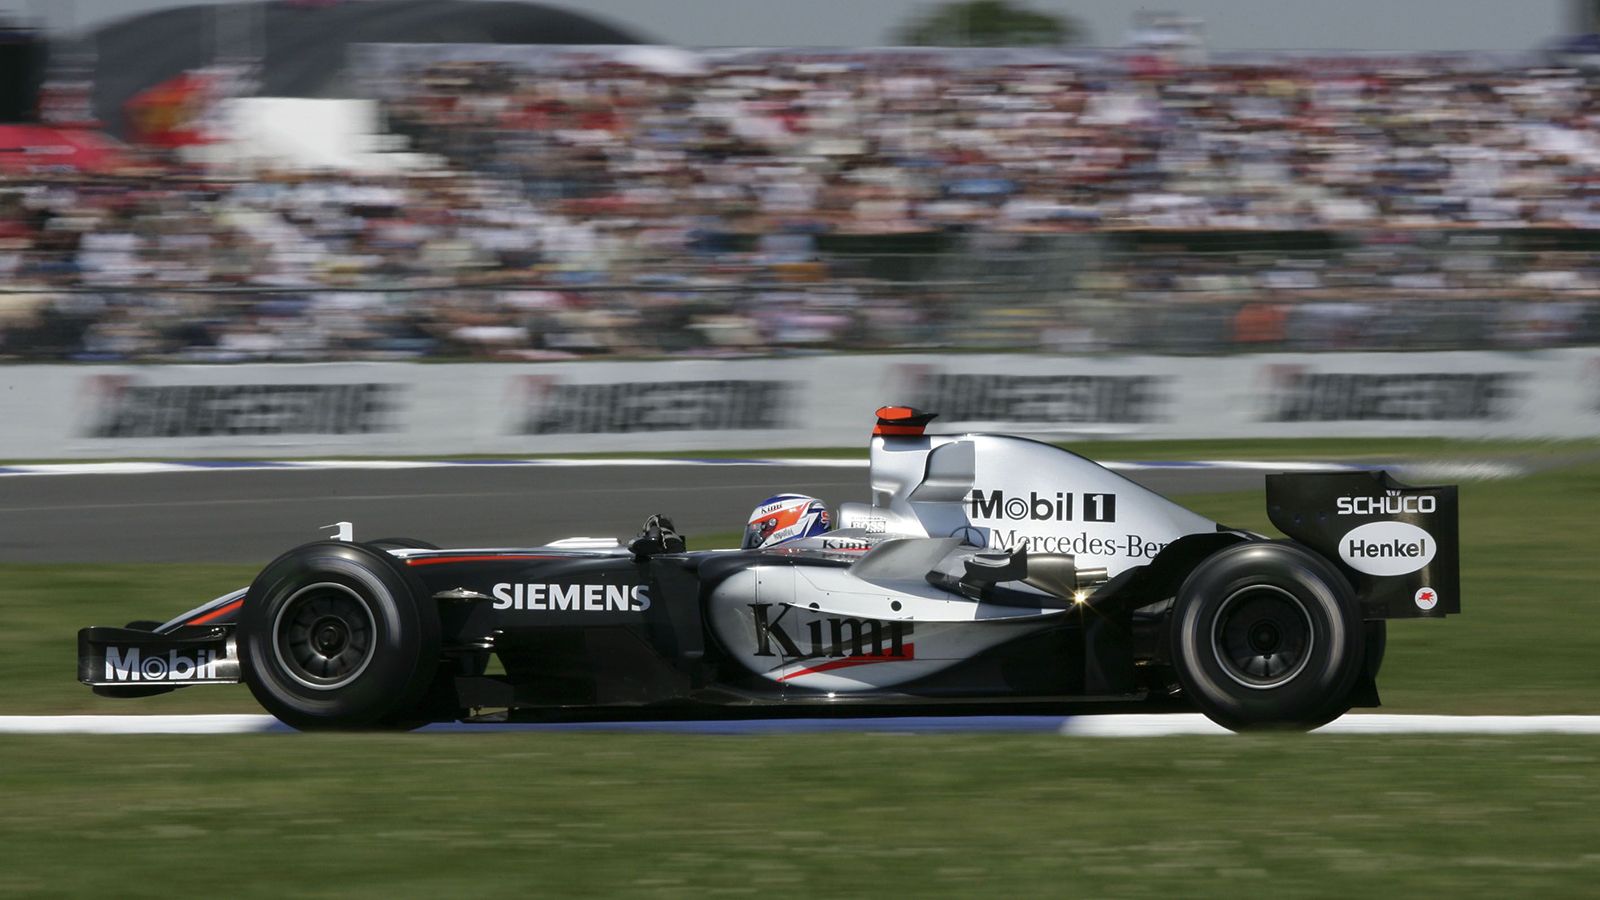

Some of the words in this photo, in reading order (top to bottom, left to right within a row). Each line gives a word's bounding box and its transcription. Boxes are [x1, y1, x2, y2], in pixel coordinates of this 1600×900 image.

[760, 503, 783, 514] Kimi
[971, 490, 1073, 521] Mobil
[1088, 494, 1108, 521] 1
[1337, 490, 1436, 514] SCHÜCO
[1350, 539, 1425, 557] Henkel
[492, 582, 651, 612] SIEMENS
[747, 602, 914, 657] Kimi
[104, 646, 216, 681] Mobil
